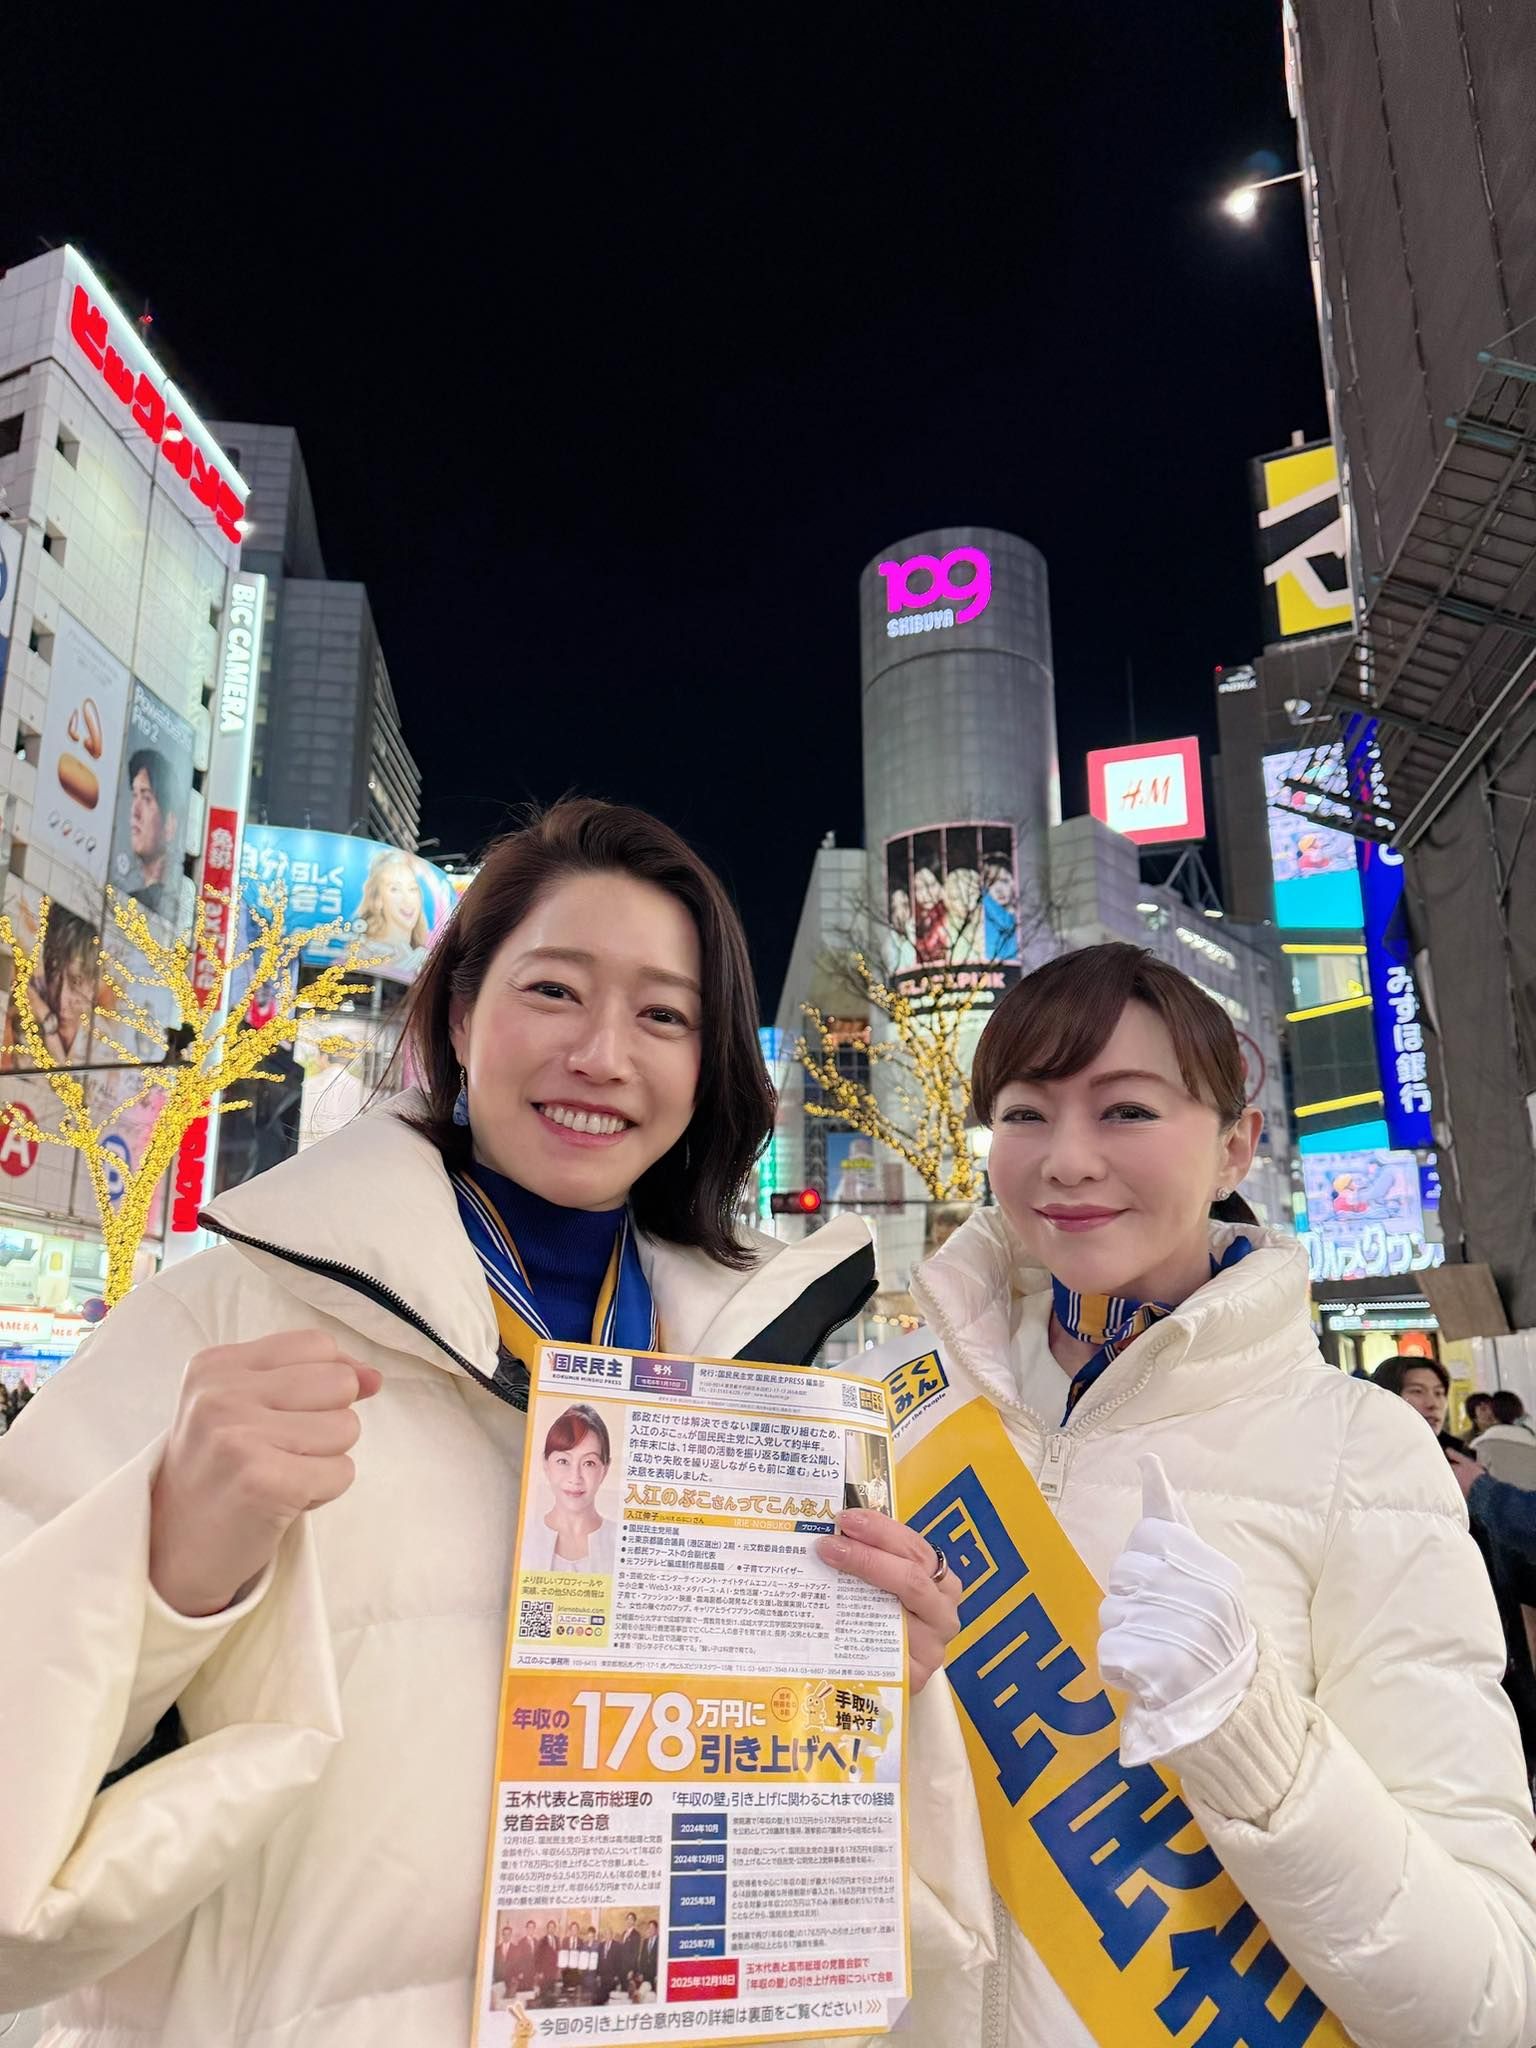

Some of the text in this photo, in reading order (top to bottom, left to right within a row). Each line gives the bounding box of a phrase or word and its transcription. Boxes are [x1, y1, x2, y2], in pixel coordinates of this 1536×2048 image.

[878, 546, 992, 624] 109
[887, 608, 954, 638] SHIBUYA
[219, 583, 257, 734] BIC CAMERA
[1386, 966, 1432, 1114] みずほ銀行
[553, 1353, 623, 1378] 国民民主
[653, 1364, 672, 1376] 号外
[894, 1378, 939, 1414] みん
[632, 1410, 841, 1440] 都政だけでは解決できない課題に取り組むため、
[627, 1465, 713, 1483] 決意を表明しました。
[624, 1484, 837, 1519] 入江のぶこさんってこんな人
[734, 1518, 791, 1531] IRIE NOBUKO
[801, 1523, 832, 1534] プロフィール
[835, 1690, 880, 1715] 手取りを
[511, 1708, 570, 1729] 年収の
[696, 1699, 767, 1729] 万円に
[836, 1711, 877, 1731] 増やす
[572, 1691, 699, 1773] 178
[538, 1735, 569, 1766] 壁
[505, 1791, 653, 1808] 玉木代表と高市総理の
[672, 1791, 895, 1808] 「年収の壁」引き上げに関わるこれまでの経緯
[503, 1814, 610, 1832] 党首会談で合意
[681, 1823, 719, 1834] 2024年10月
[674, 1853, 724, 1865] 2024年12月11日
[680, 1896, 716, 1907] 2025年3月
[680, 1938, 715, 1949] 2025年7月
[670, 1974, 736, 1988] 2025年12月18日
